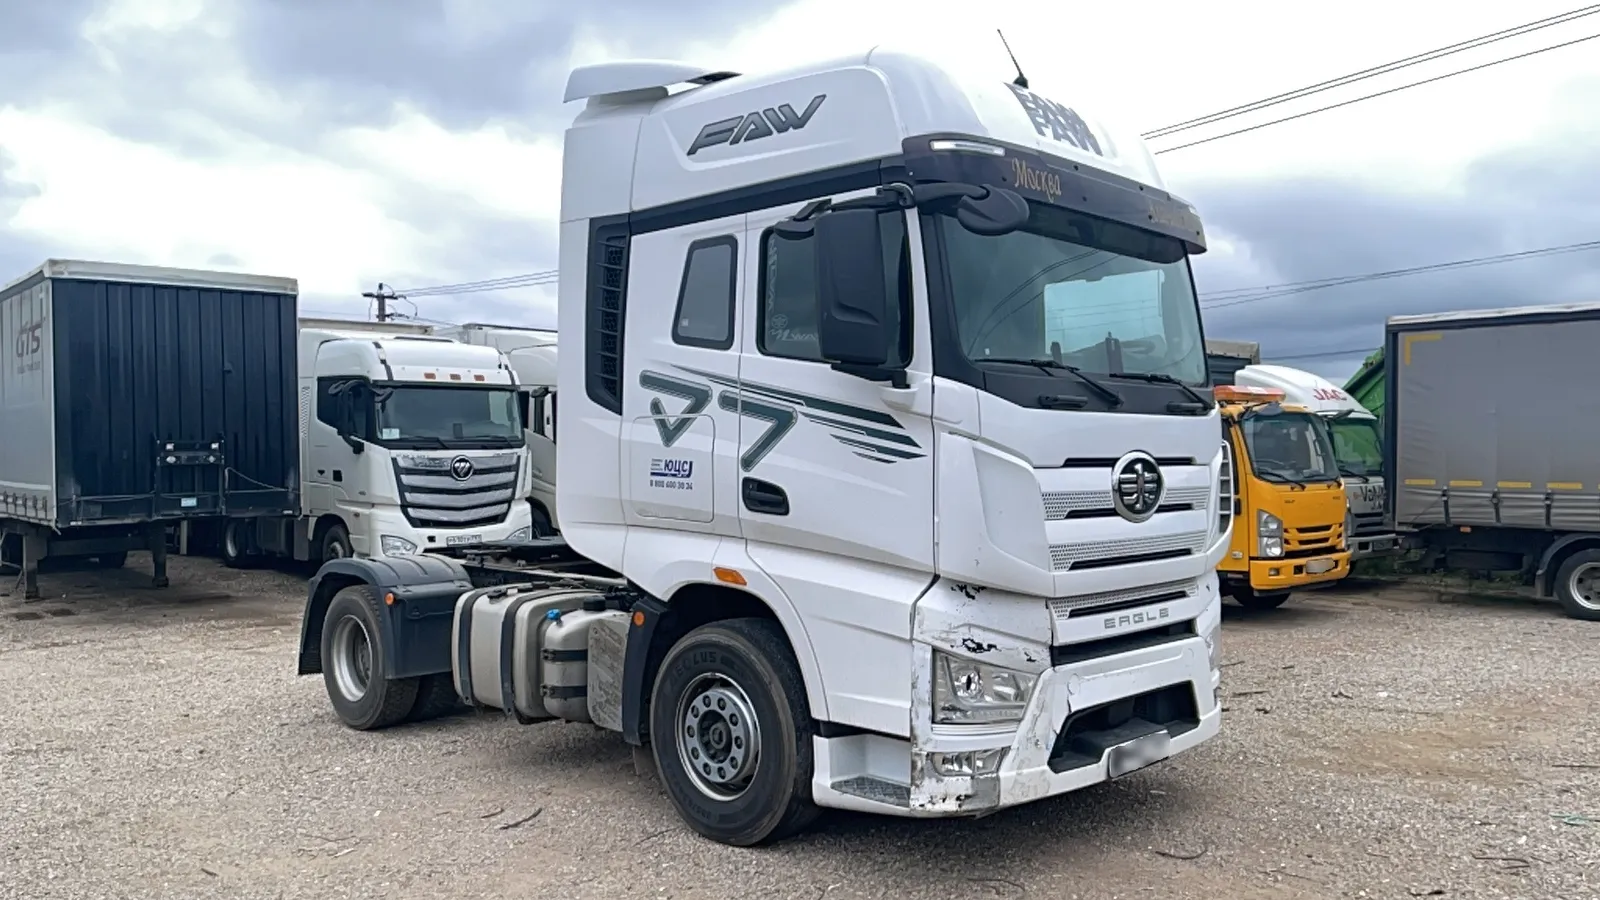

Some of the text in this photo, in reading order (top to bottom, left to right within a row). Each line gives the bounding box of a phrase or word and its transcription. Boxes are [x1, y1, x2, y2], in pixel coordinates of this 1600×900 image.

[687, 94, 827, 156] FAW
[1011, 157, 1062, 204] Москва
[1313, 388, 1347, 401] JAC
[1104, 607, 1170, 629] EAGLE
